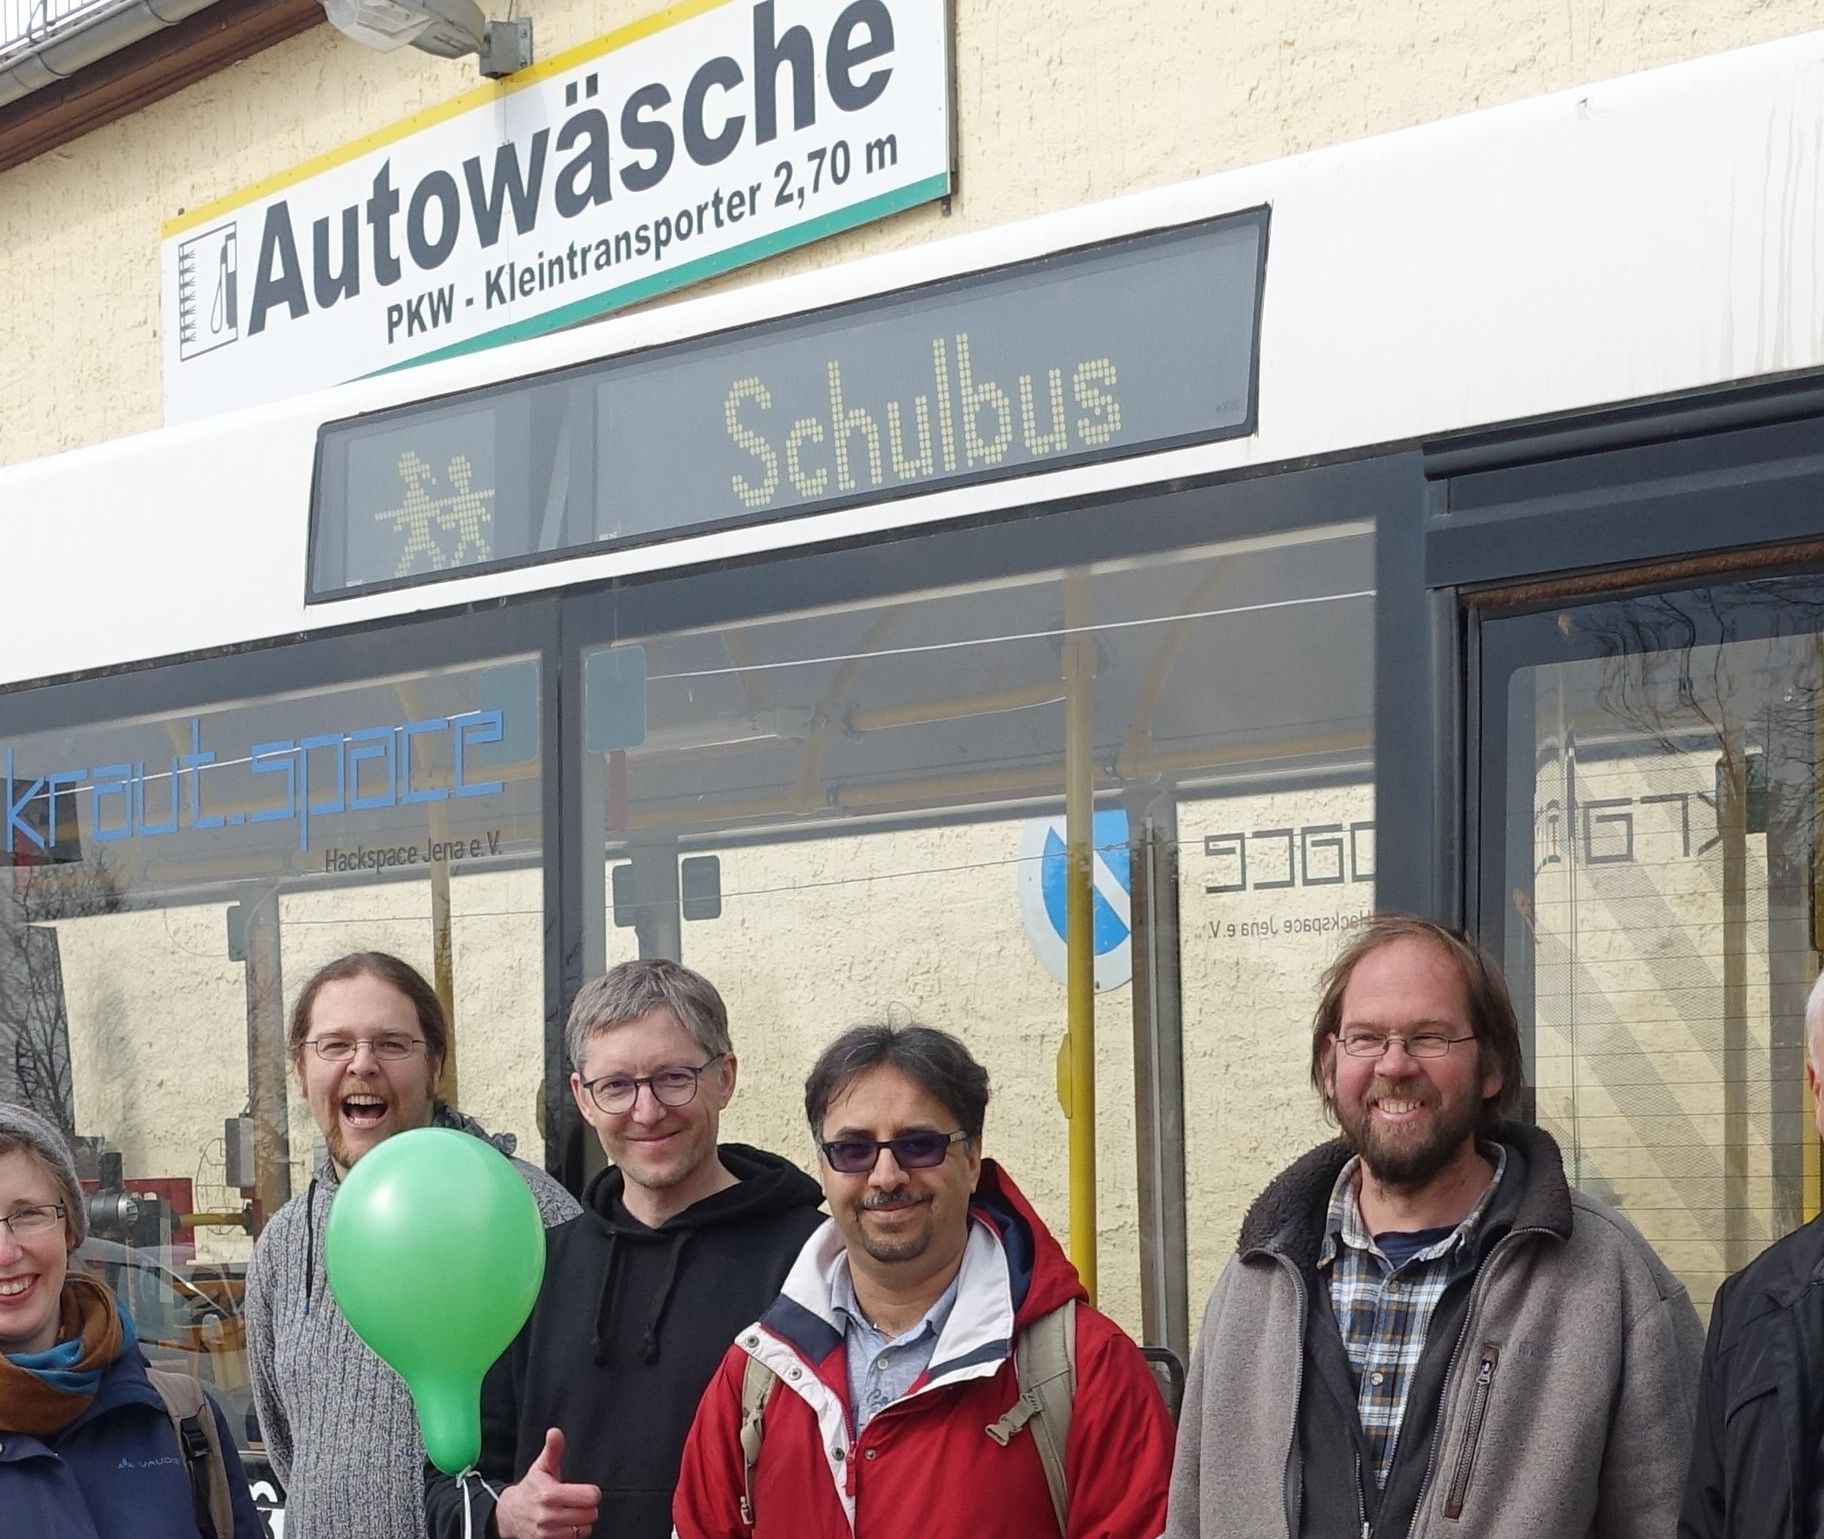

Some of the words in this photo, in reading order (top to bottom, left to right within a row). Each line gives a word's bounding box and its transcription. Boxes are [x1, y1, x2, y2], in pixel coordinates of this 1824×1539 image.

[247, 0, 895, 337] Autowäsche
[386, 283, 455, 345] PKW
[484, 180, 763, 310] Kleintransporter
[773, 138, 851, 211] 2,70
[864, 132, 899, 175] m
[723, 332, 1122, 509] Schulbus
[325, 843, 418, 874] Hackspace
[422, 837, 465, 863] Jena
